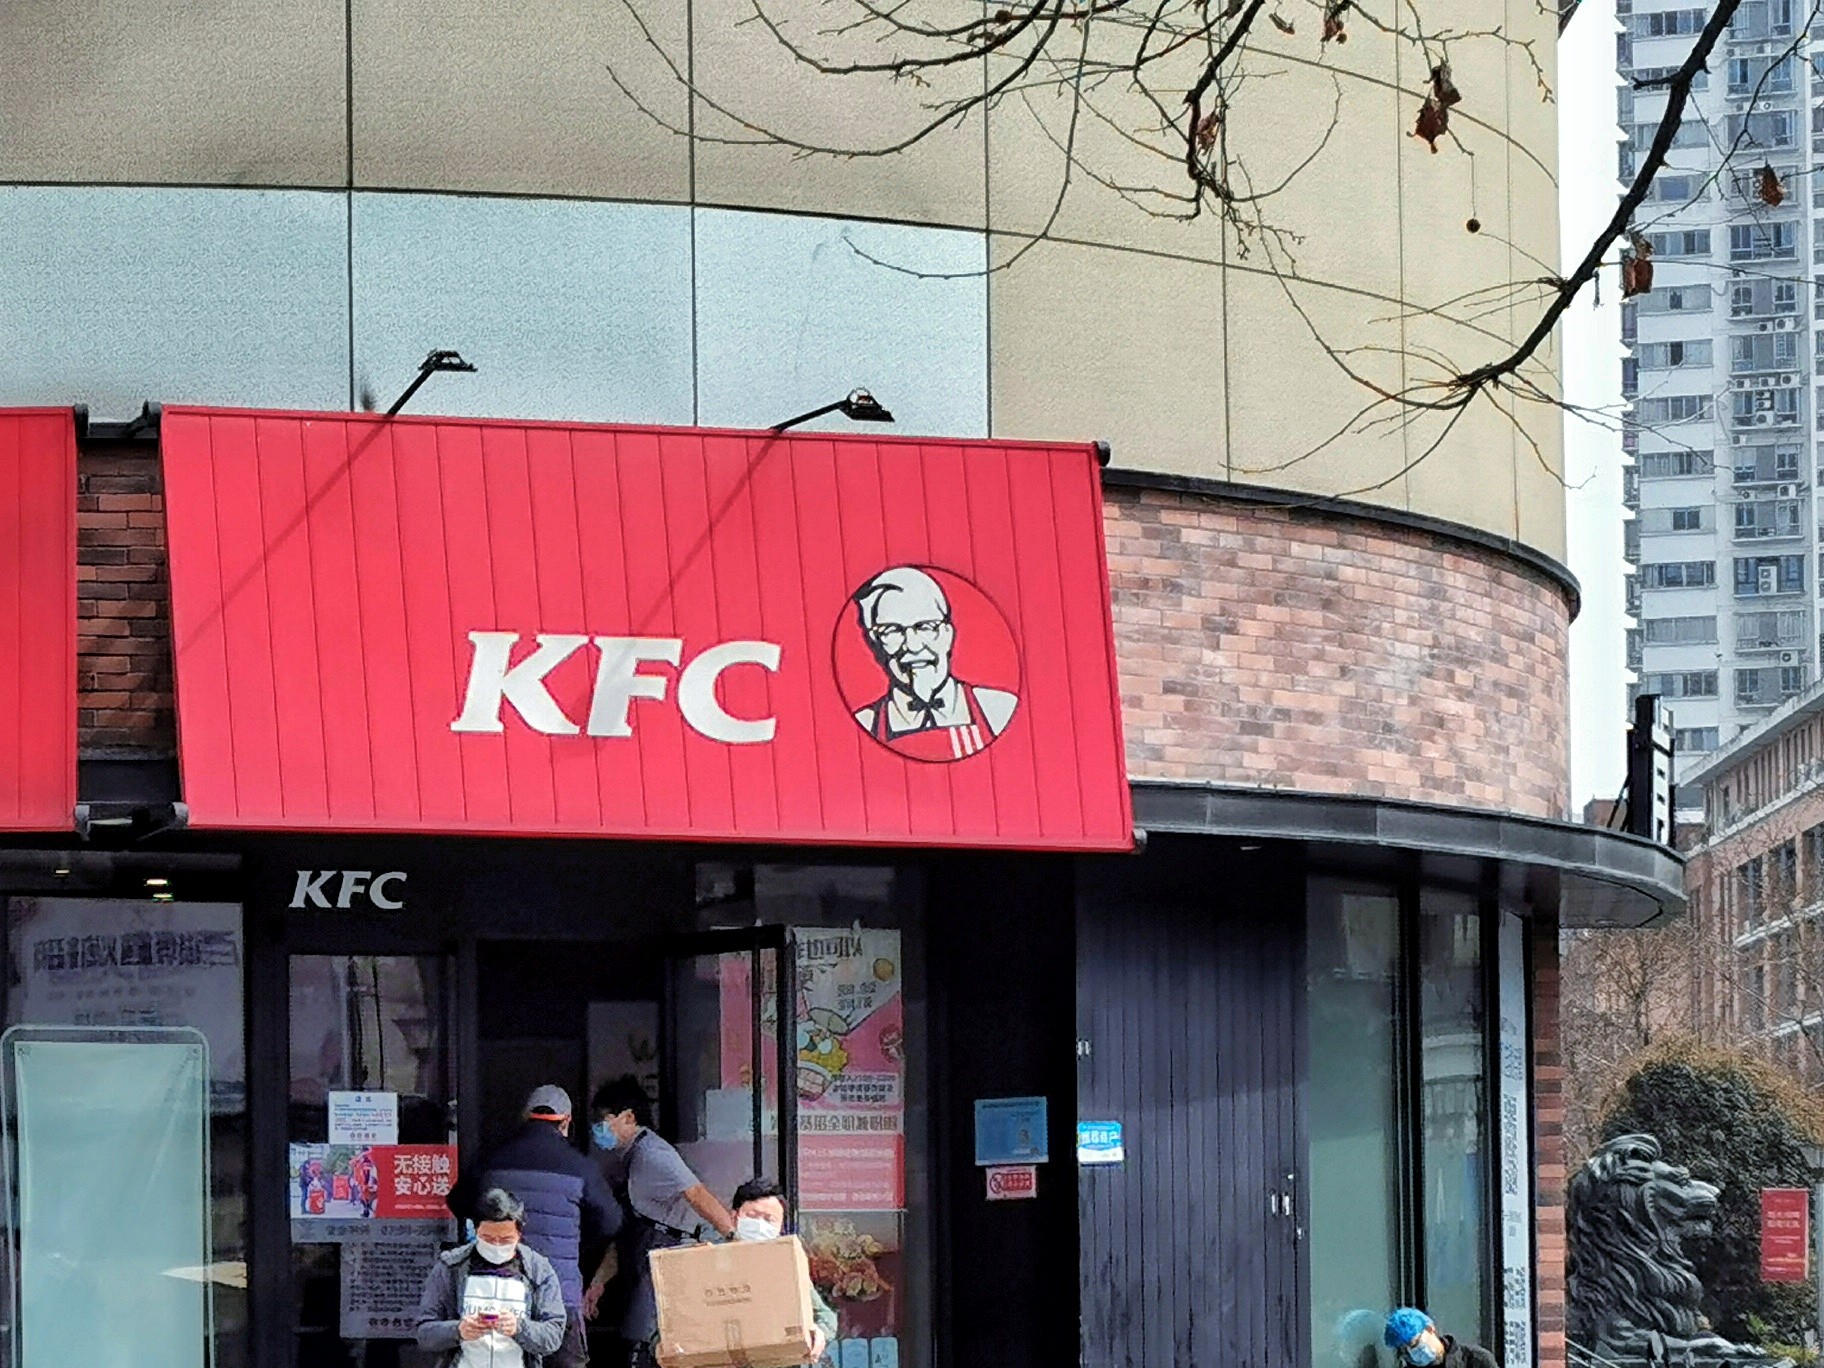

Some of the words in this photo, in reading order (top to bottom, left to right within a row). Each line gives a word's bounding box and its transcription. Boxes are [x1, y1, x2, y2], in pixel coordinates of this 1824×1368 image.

[450, 631, 780, 744] KFC
[288, 870, 407, 909] KFC
[393, 1153, 451, 1175] 无接触
[393, 1176, 452, 1196] 安心送
